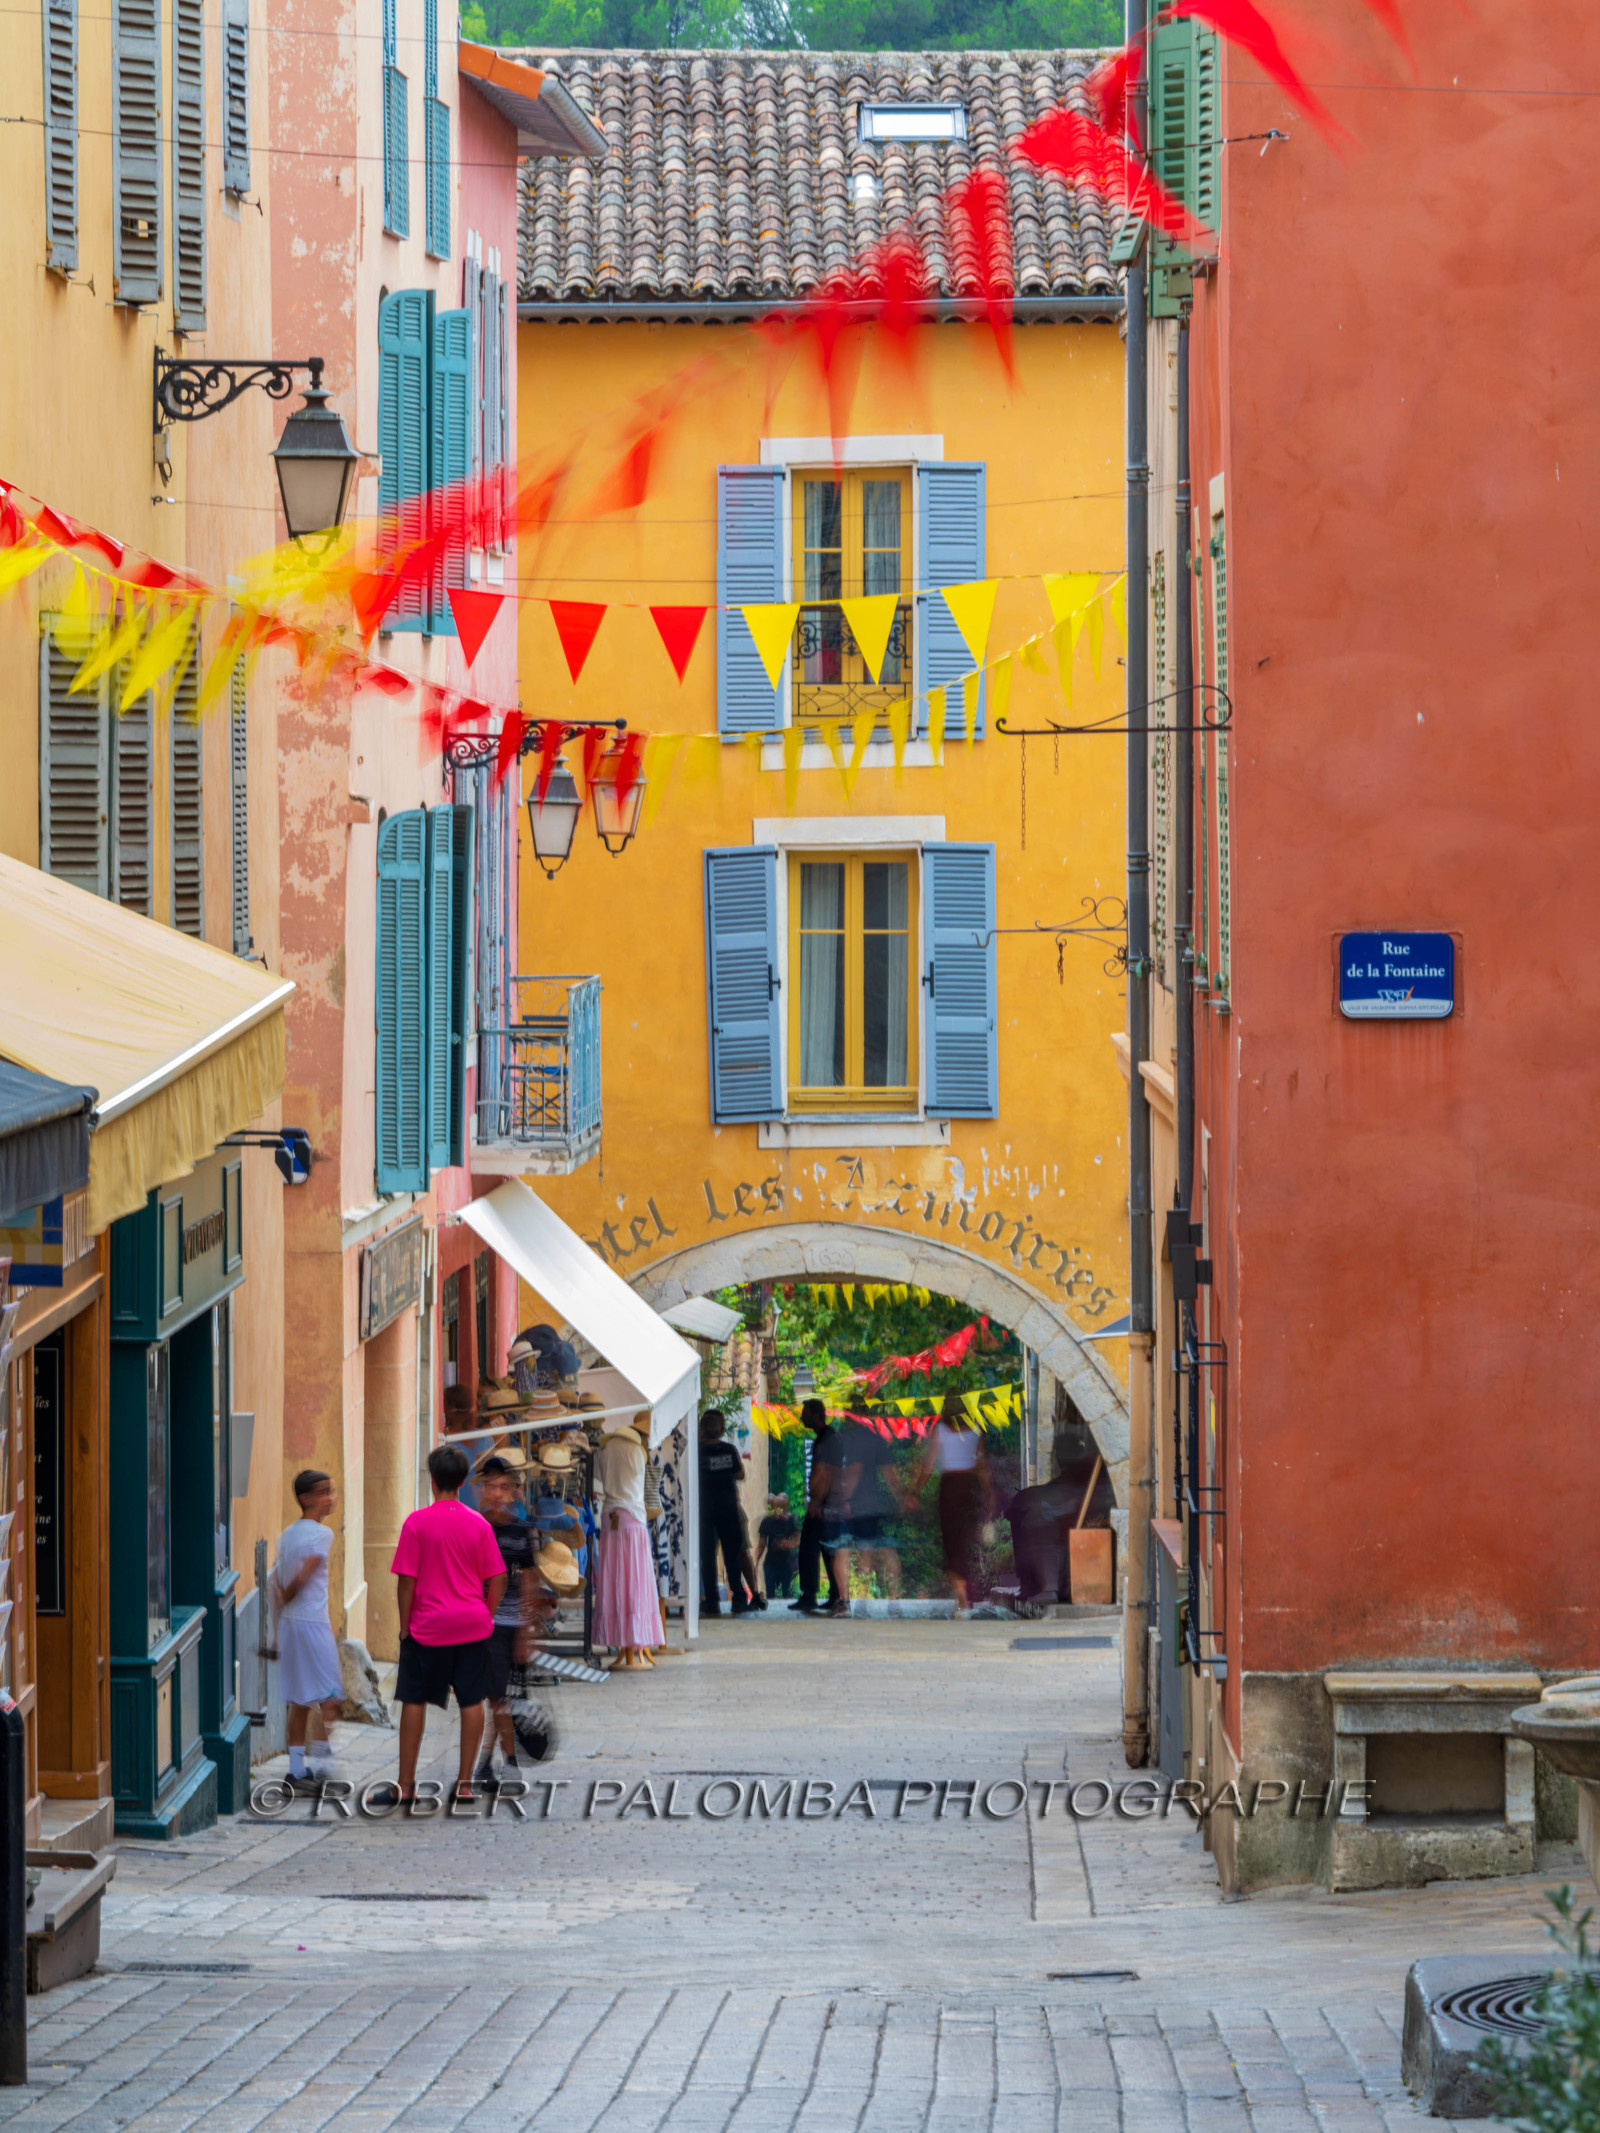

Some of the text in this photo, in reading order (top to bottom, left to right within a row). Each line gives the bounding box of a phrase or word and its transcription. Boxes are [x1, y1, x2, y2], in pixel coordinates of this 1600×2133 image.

[1382, 941, 1411, 955] Rue
[1346, 963, 1446, 978] de la Fontaine
